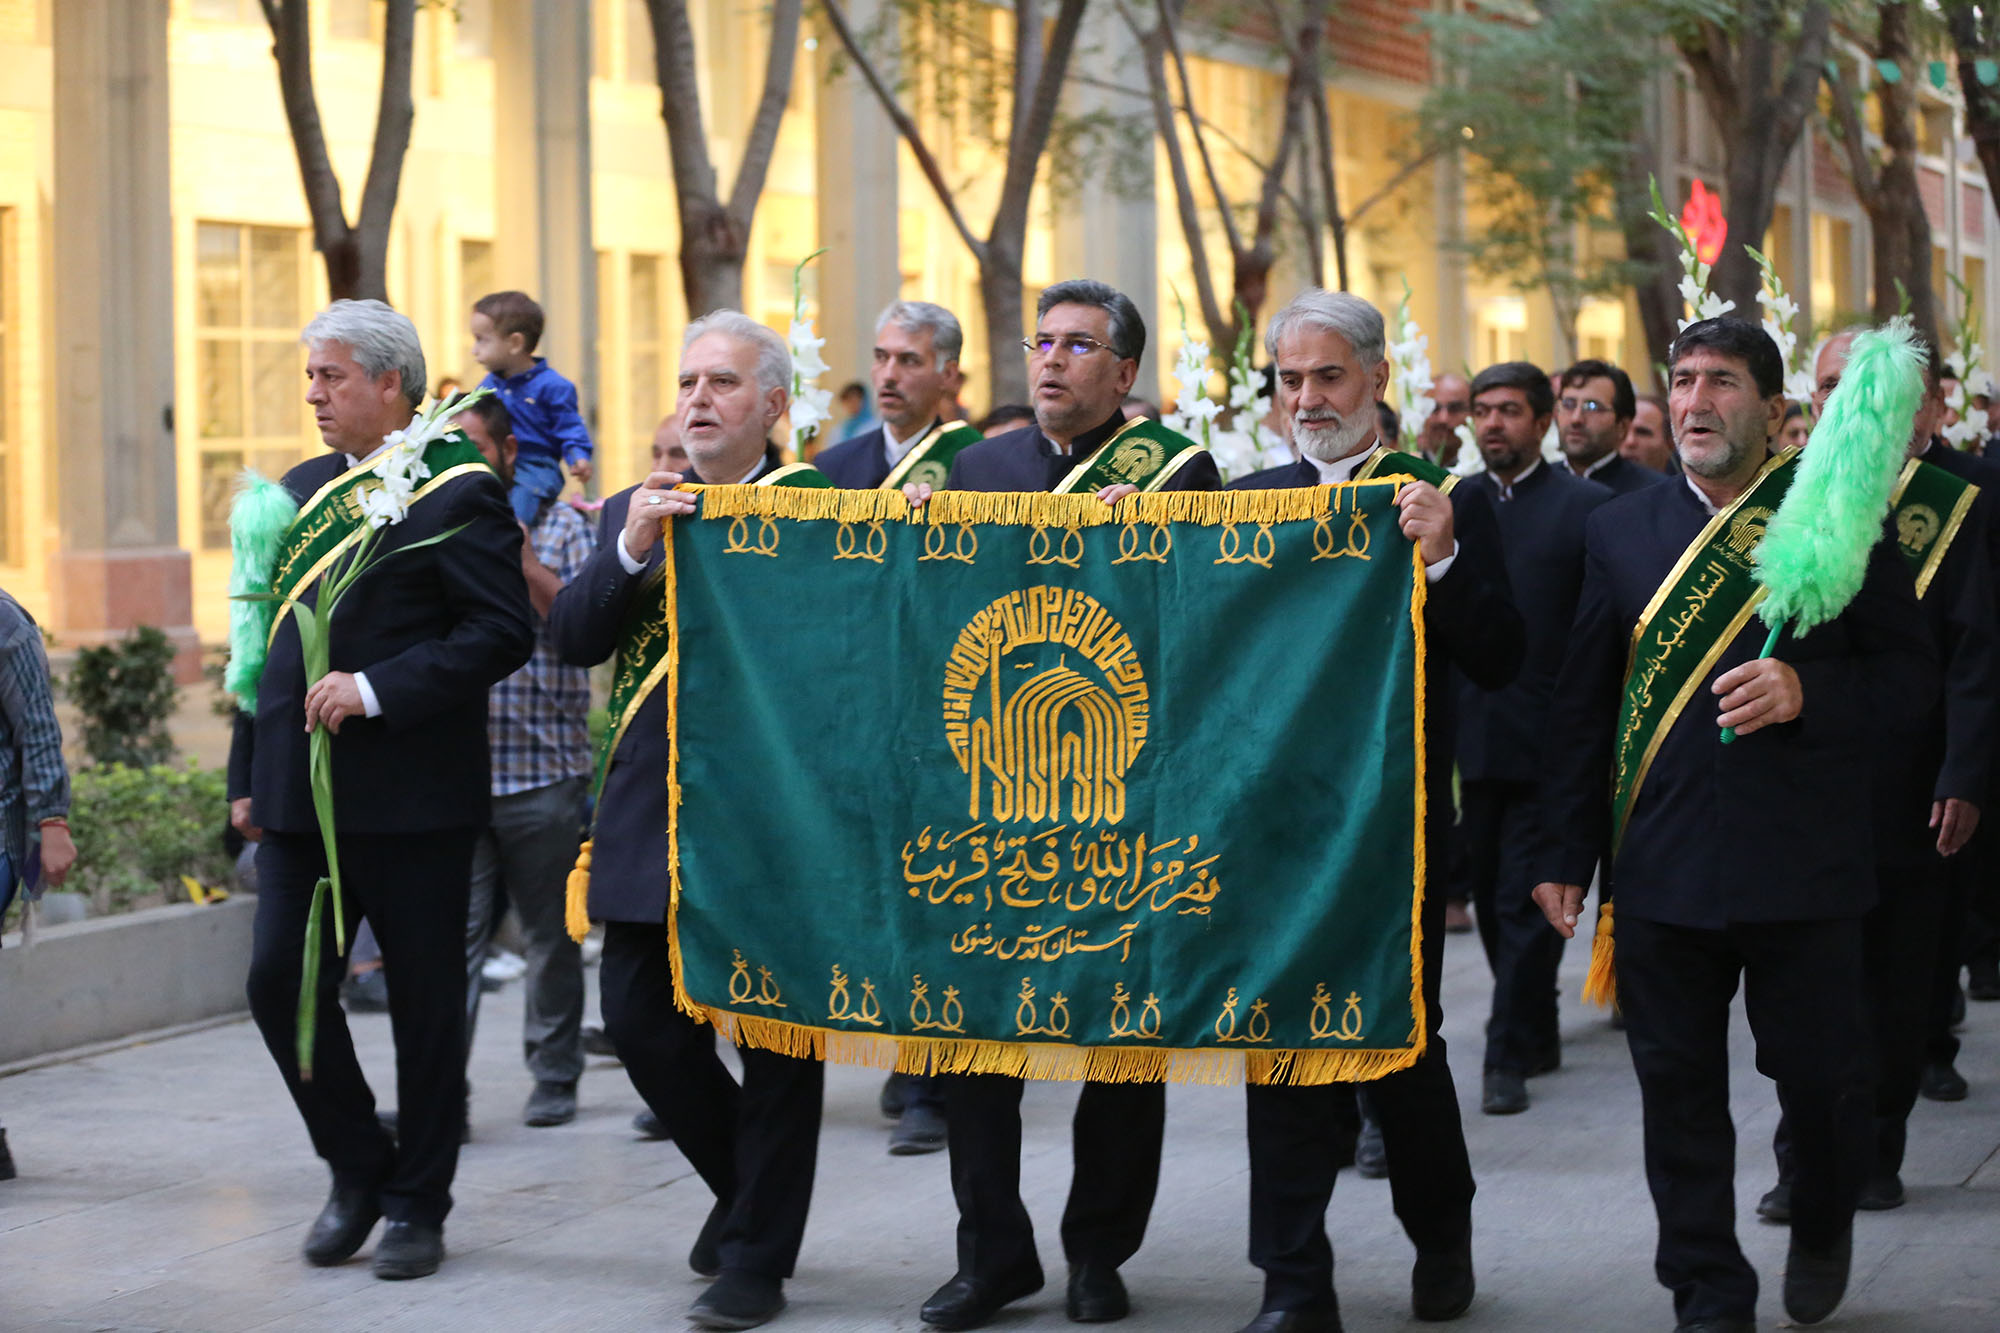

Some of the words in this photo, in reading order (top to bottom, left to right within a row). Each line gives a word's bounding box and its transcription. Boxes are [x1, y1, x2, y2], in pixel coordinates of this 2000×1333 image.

[951, 923, 999, 955] رضوی
[998, 924, 1067, 960] قدس
[1041, 920, 1140, 963] آستان
